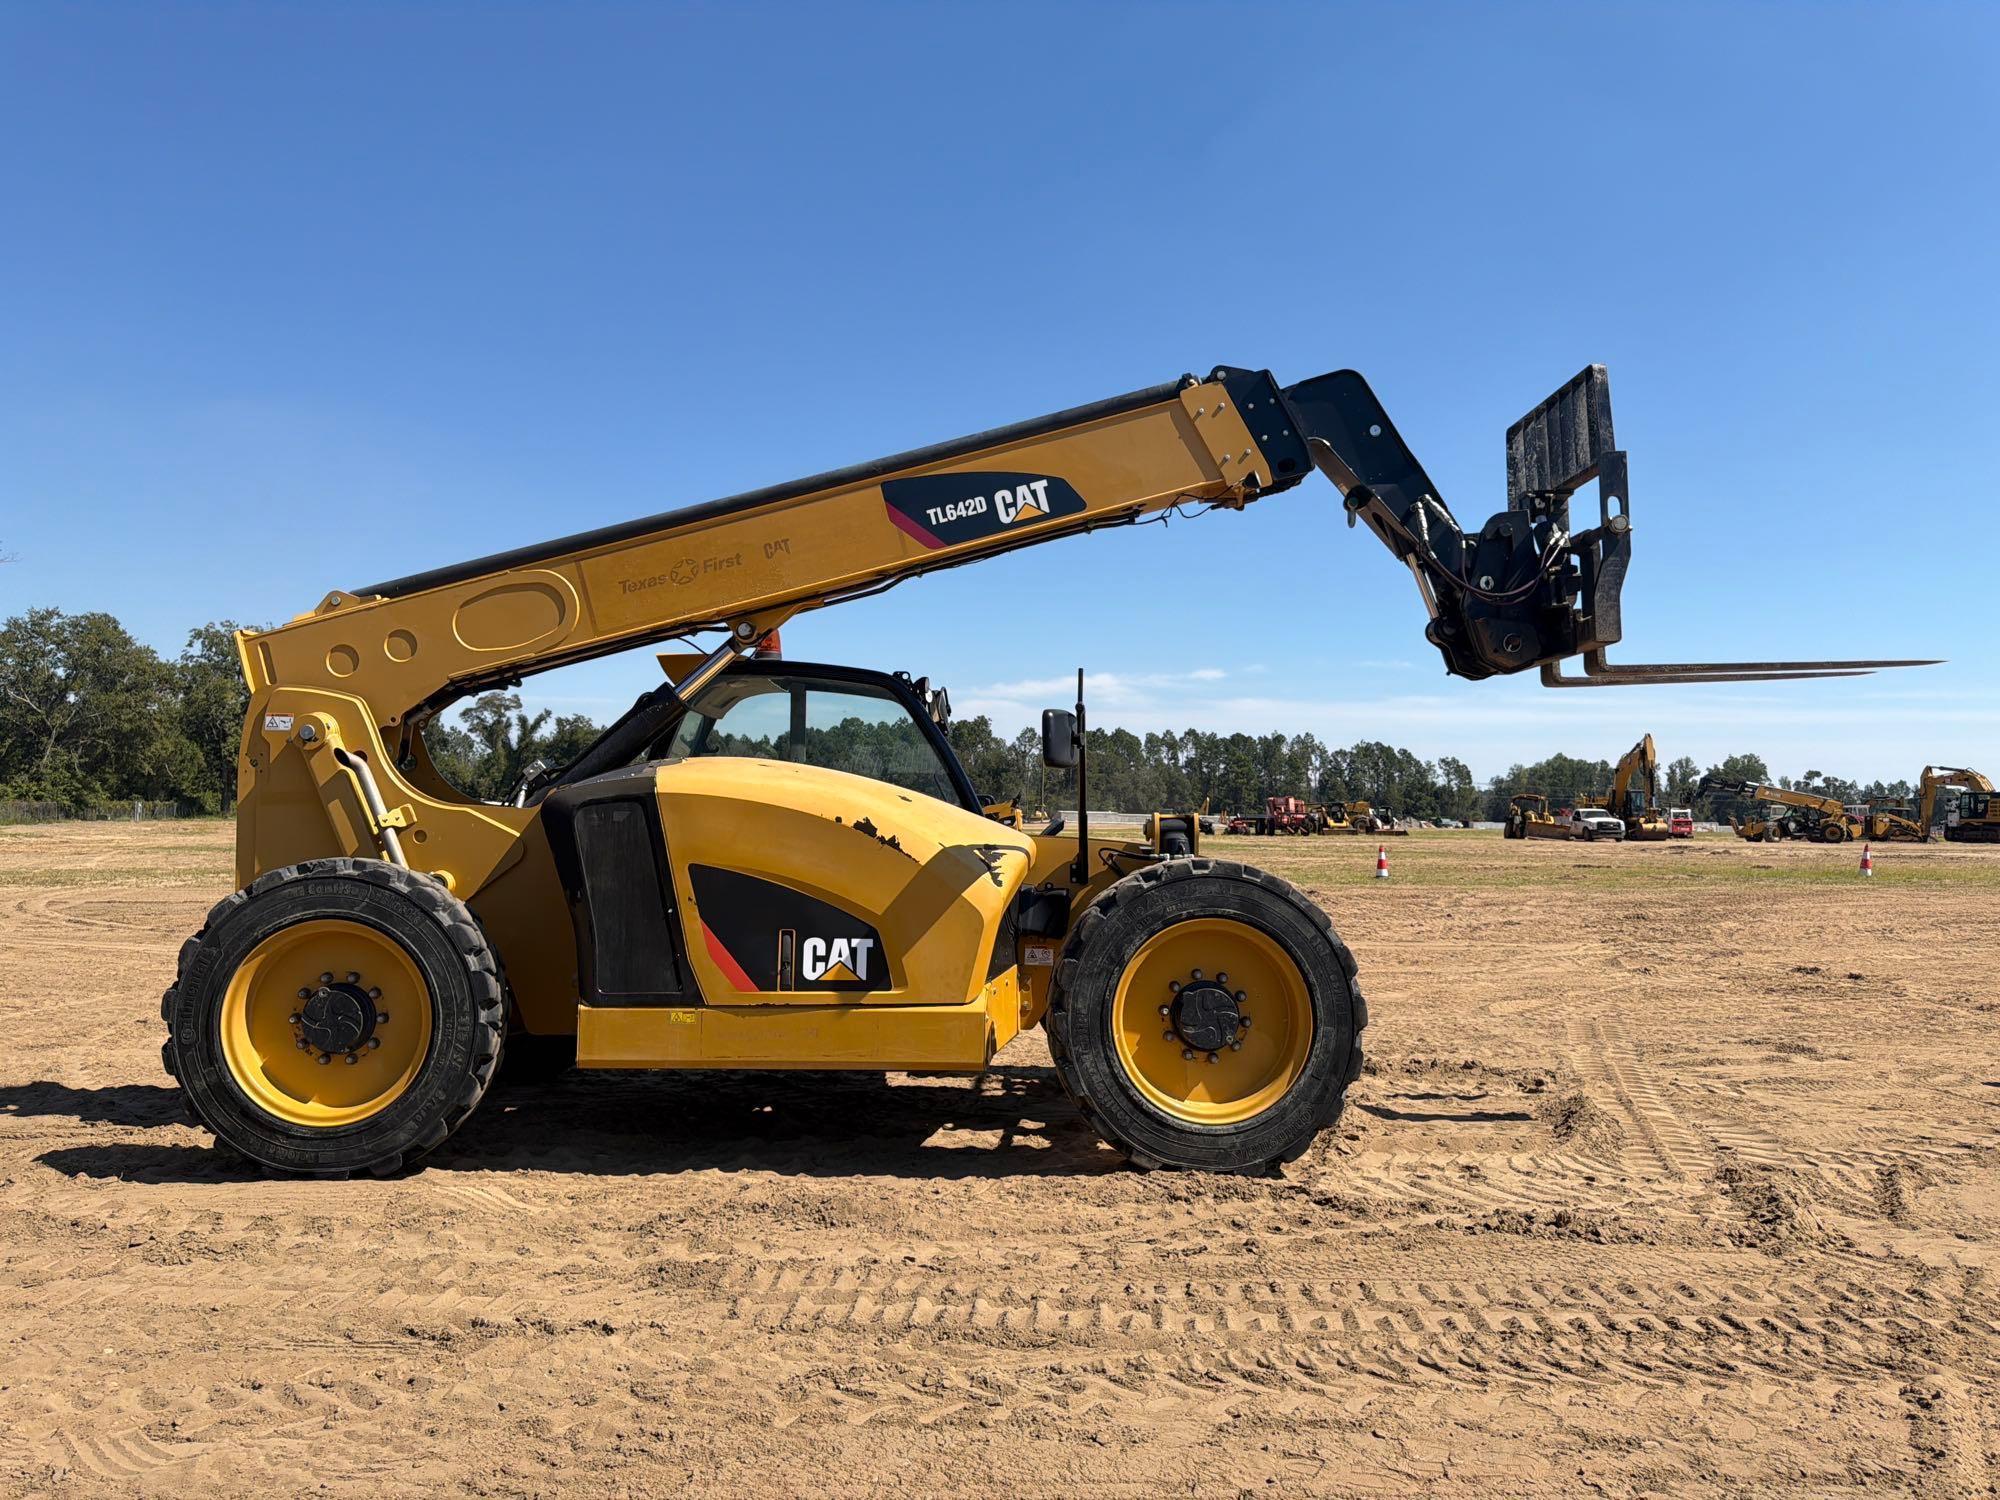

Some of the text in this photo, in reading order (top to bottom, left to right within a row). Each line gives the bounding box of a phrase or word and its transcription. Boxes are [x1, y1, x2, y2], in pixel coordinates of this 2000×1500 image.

[926, 479, 1050, 526] TL642D CAT
[618, 538, 790, 595] Texas First CAT
[802, 937, 874, 981] CAT
